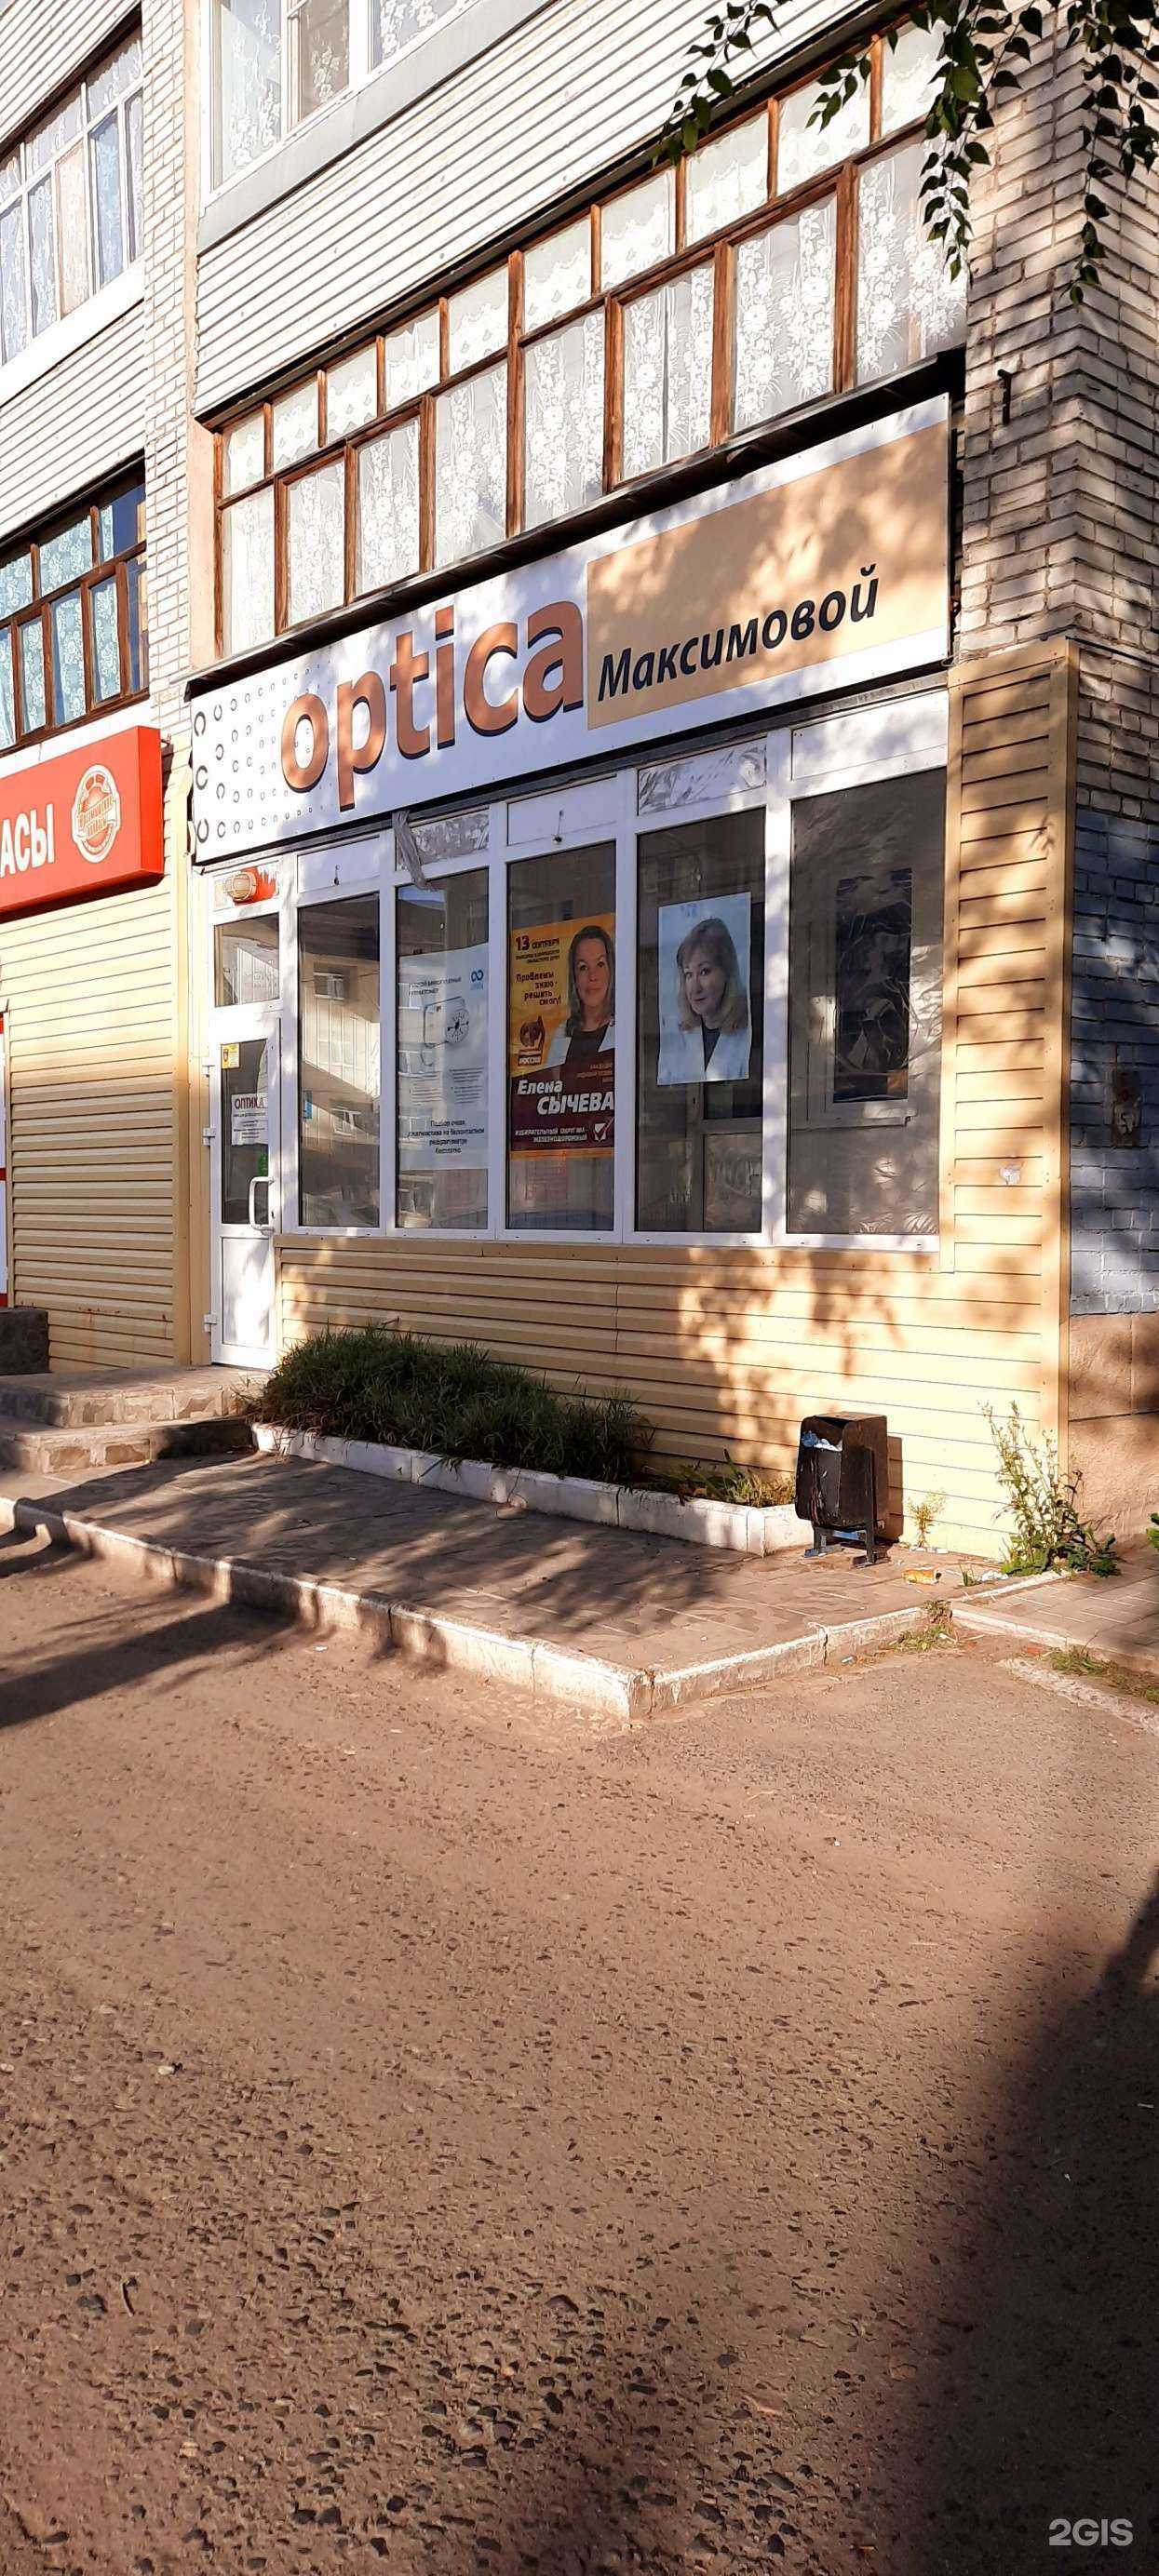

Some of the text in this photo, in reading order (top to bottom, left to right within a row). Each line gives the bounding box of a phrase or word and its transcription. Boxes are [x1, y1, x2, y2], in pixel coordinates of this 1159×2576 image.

[598, 564, 878, 703] Максимовой
[281, 601, 586, 812] optica
[0, 803, 55, 879] АСЫ
[516, 935, 530, 950] 13
[517, 1080, 563, 1095] Елена
[537, 1091, 614, 1115] СЫЧЕВА
